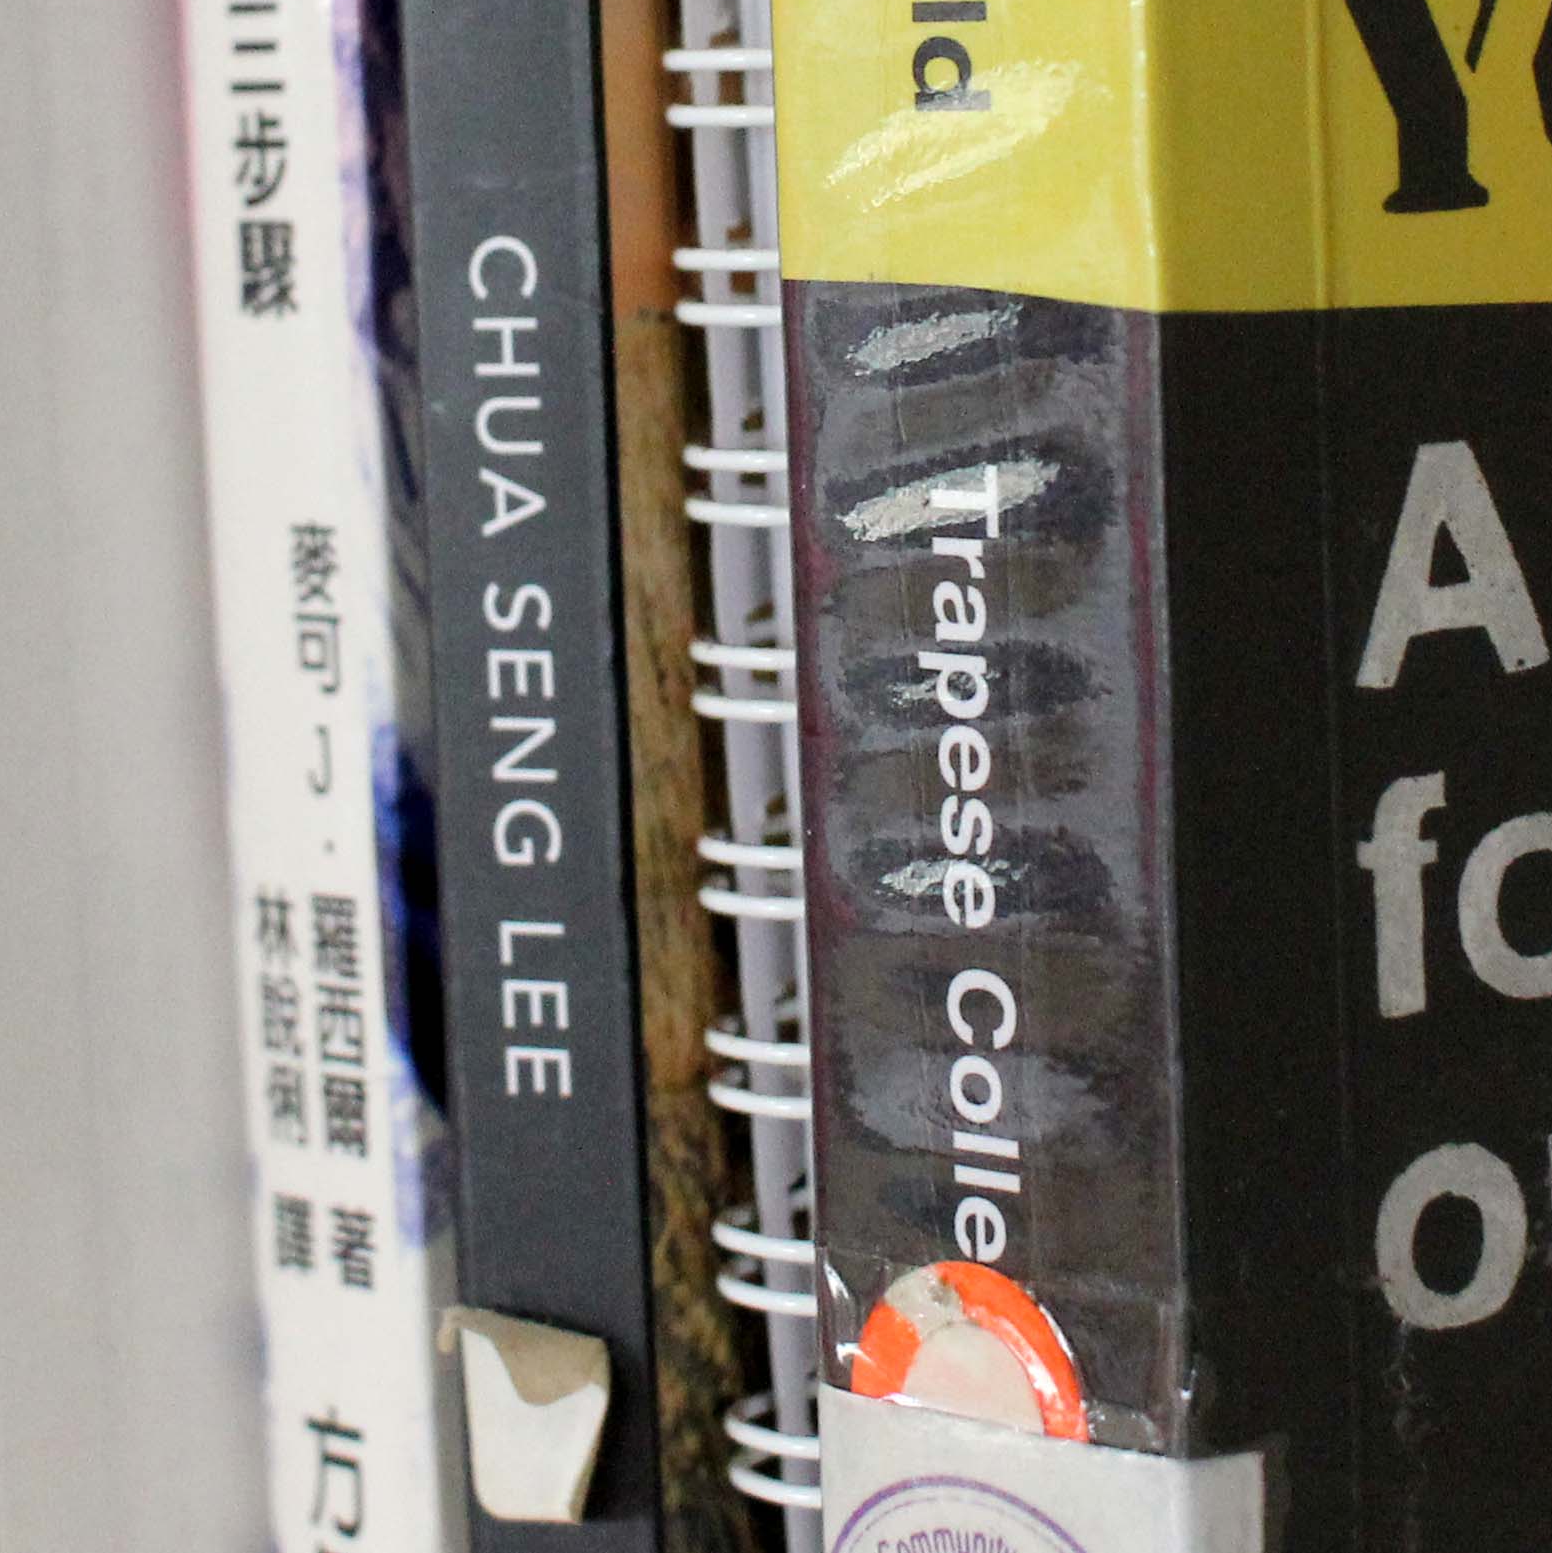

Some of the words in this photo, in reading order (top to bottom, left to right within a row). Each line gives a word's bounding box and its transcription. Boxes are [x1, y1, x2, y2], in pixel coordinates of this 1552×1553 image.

[467, 234, 547, 538] CHUA
[917, 463, 1000, 930] Trapese
[1356, 438, 1550, 690] A
[482, 581, 562, 867] SENG
[498, 920, 573, 1099] LEE
